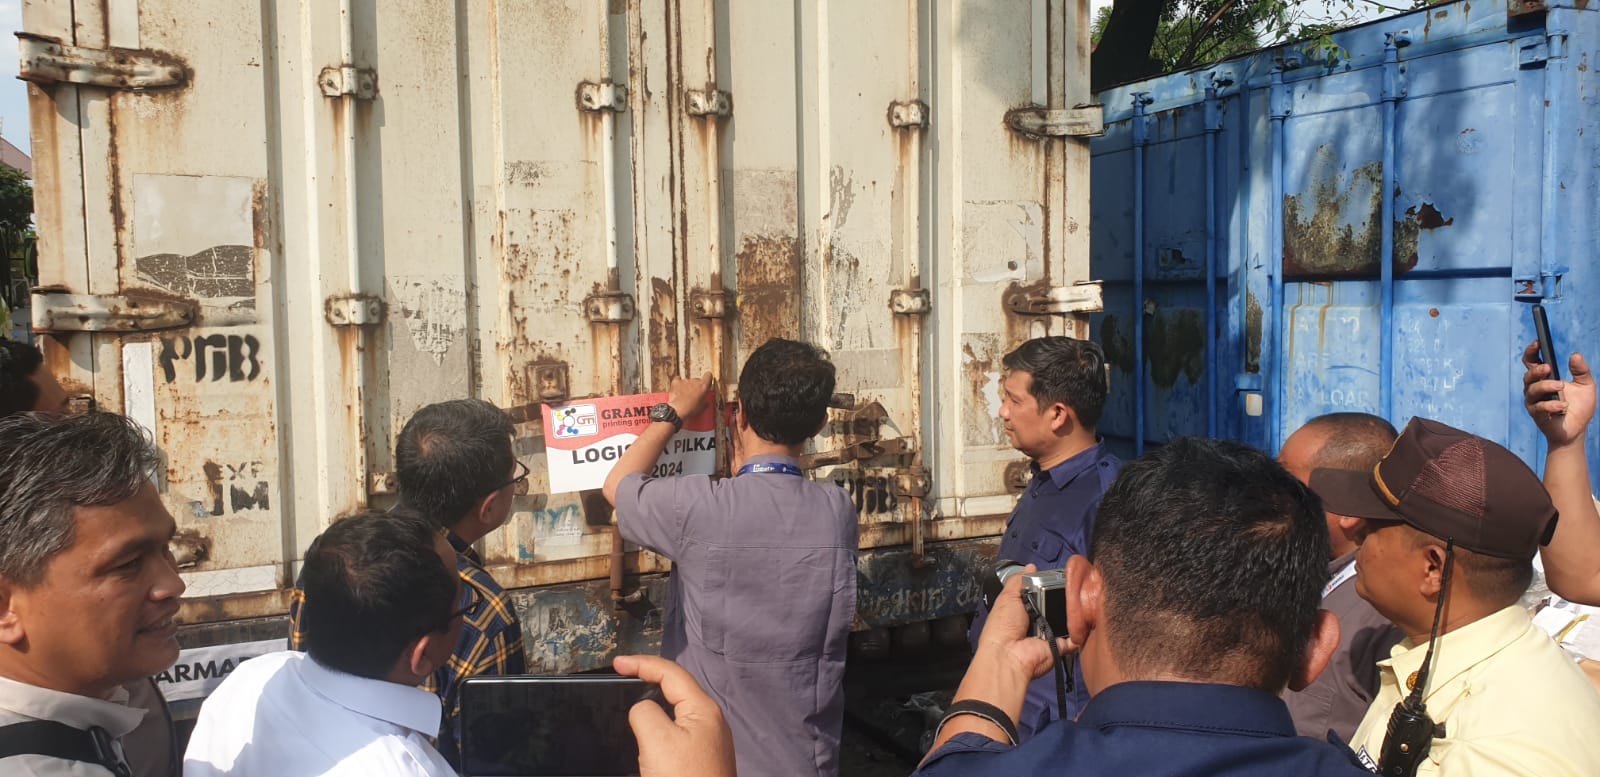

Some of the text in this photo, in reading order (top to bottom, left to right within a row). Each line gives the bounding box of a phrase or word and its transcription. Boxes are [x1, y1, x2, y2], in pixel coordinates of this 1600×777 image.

[602, 416, 652, 428] printing grou
[675, 436, 716, 453] PILKA
[651, 461, 683, 479] 2024
[155, 656, 251, 684] ARMA
